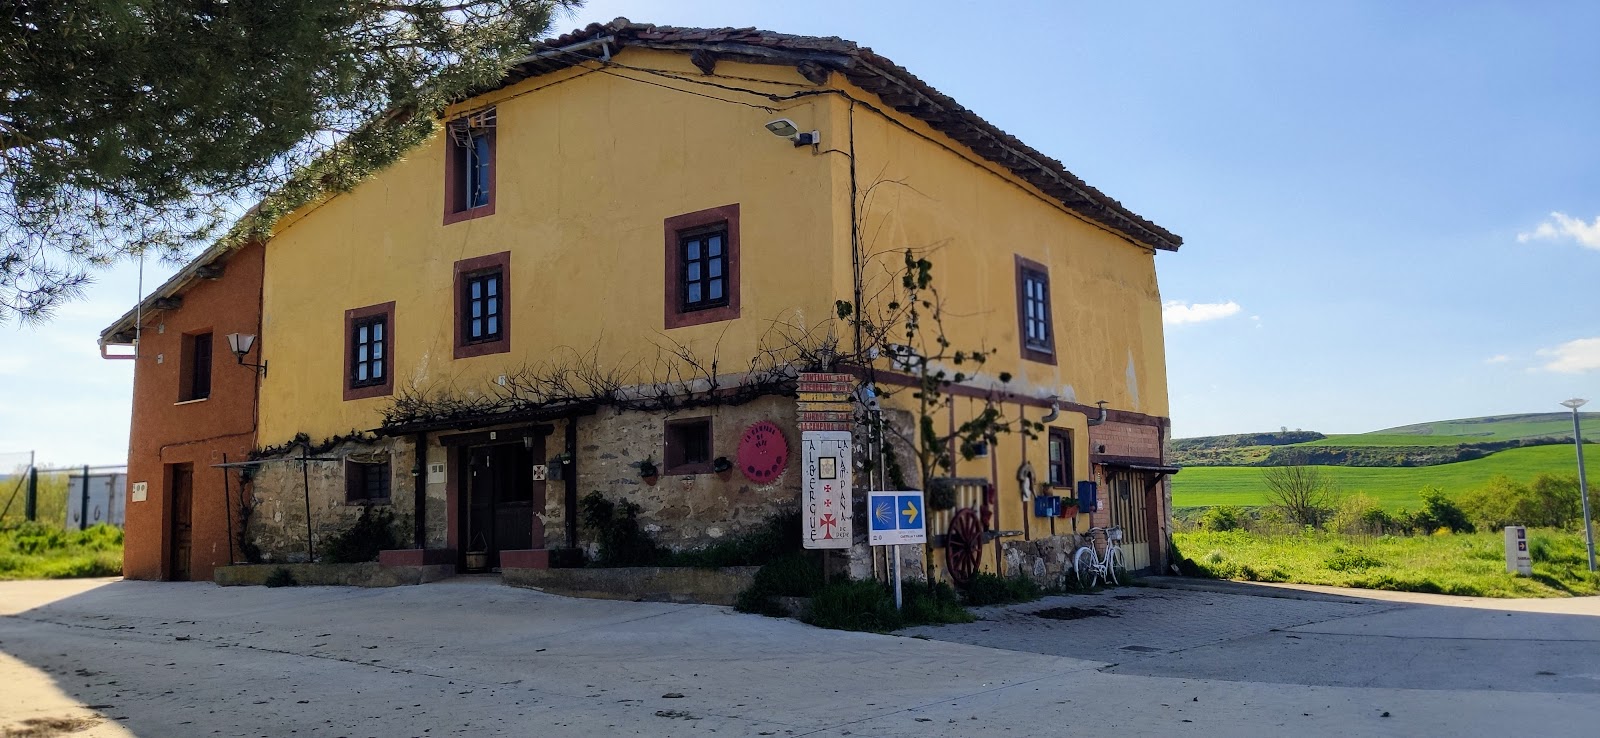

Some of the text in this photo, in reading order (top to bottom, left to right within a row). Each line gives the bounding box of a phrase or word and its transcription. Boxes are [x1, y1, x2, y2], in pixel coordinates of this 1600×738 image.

[802, 373, 832, 381] SANTIAGO
[803, 412, 827, 421] BURGOS
[810, 422, 834, 431] CAMPANA
[745, 425, 775, 443] LA CAMPANA
[755, 440, 767, 448] PEPE
[837, 440, 848, 449] LA
